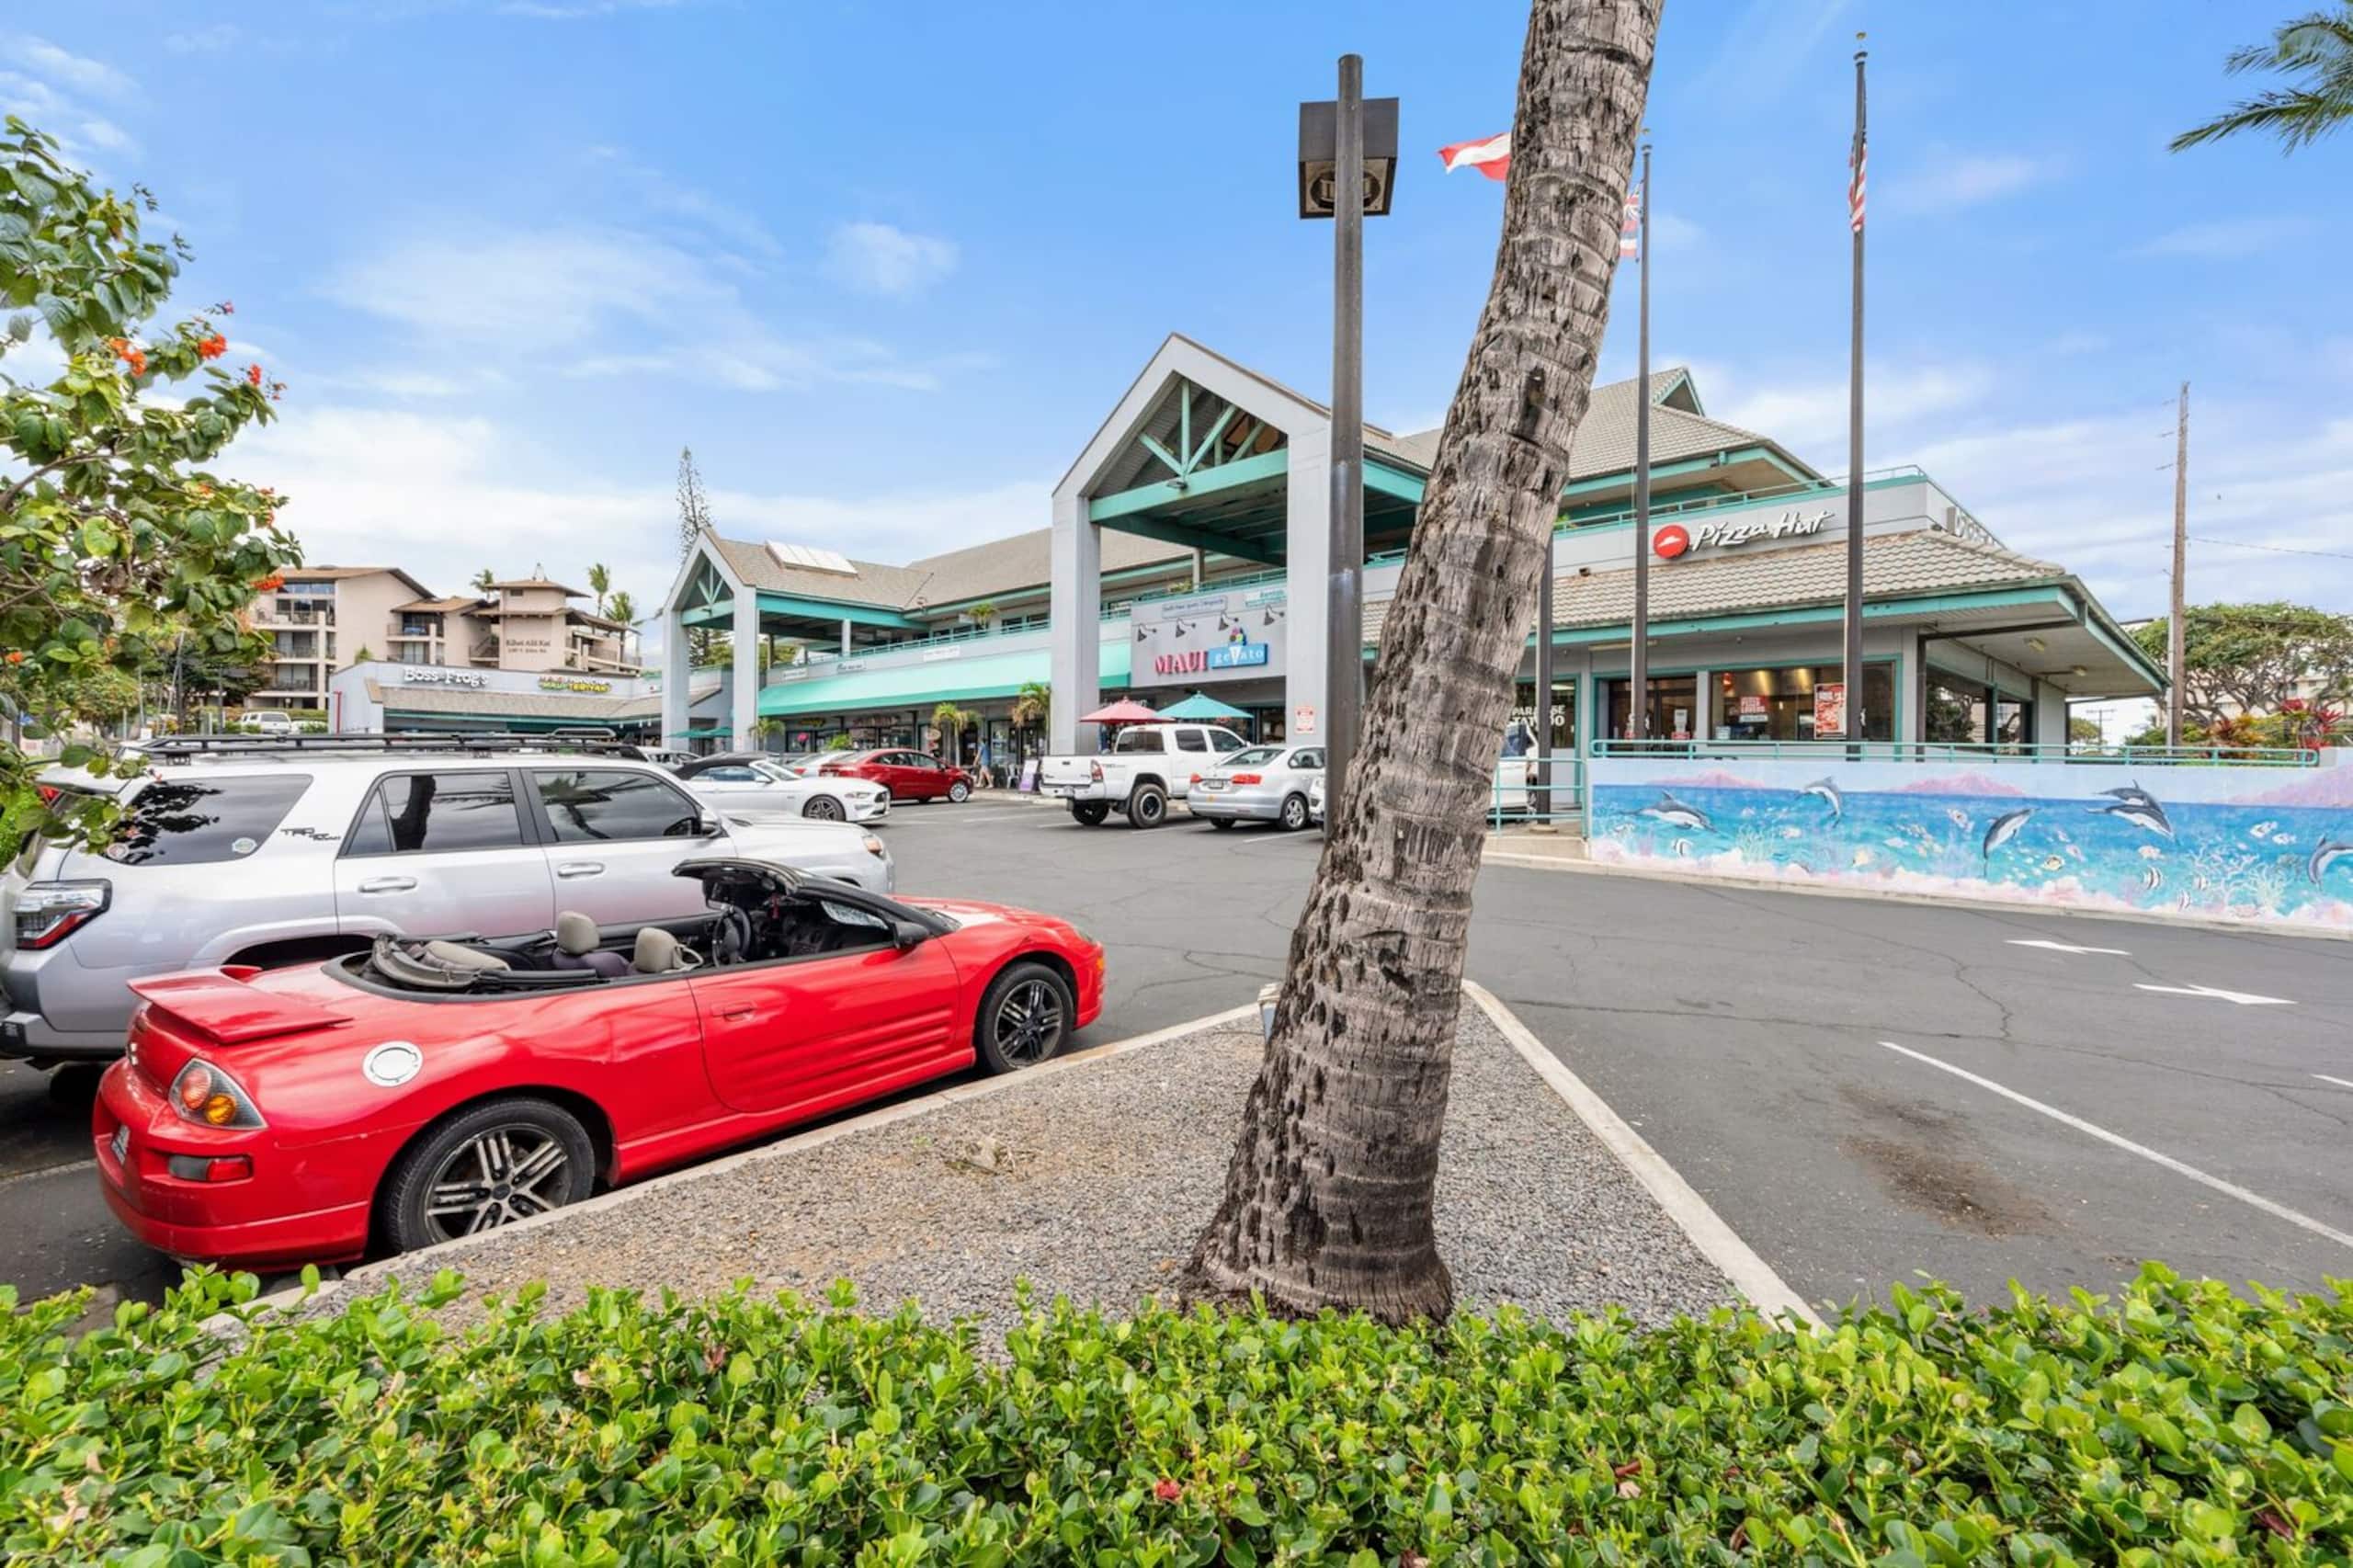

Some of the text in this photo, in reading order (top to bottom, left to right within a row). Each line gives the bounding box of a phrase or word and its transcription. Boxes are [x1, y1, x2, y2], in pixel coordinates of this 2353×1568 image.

[1692, 509, 1836, 552] Pizza Hut
[1154, 649, 1209, 676] MAUI
[404, 666, 439, 682] Boss
[1512, 704, 1566, 715] PARSE
